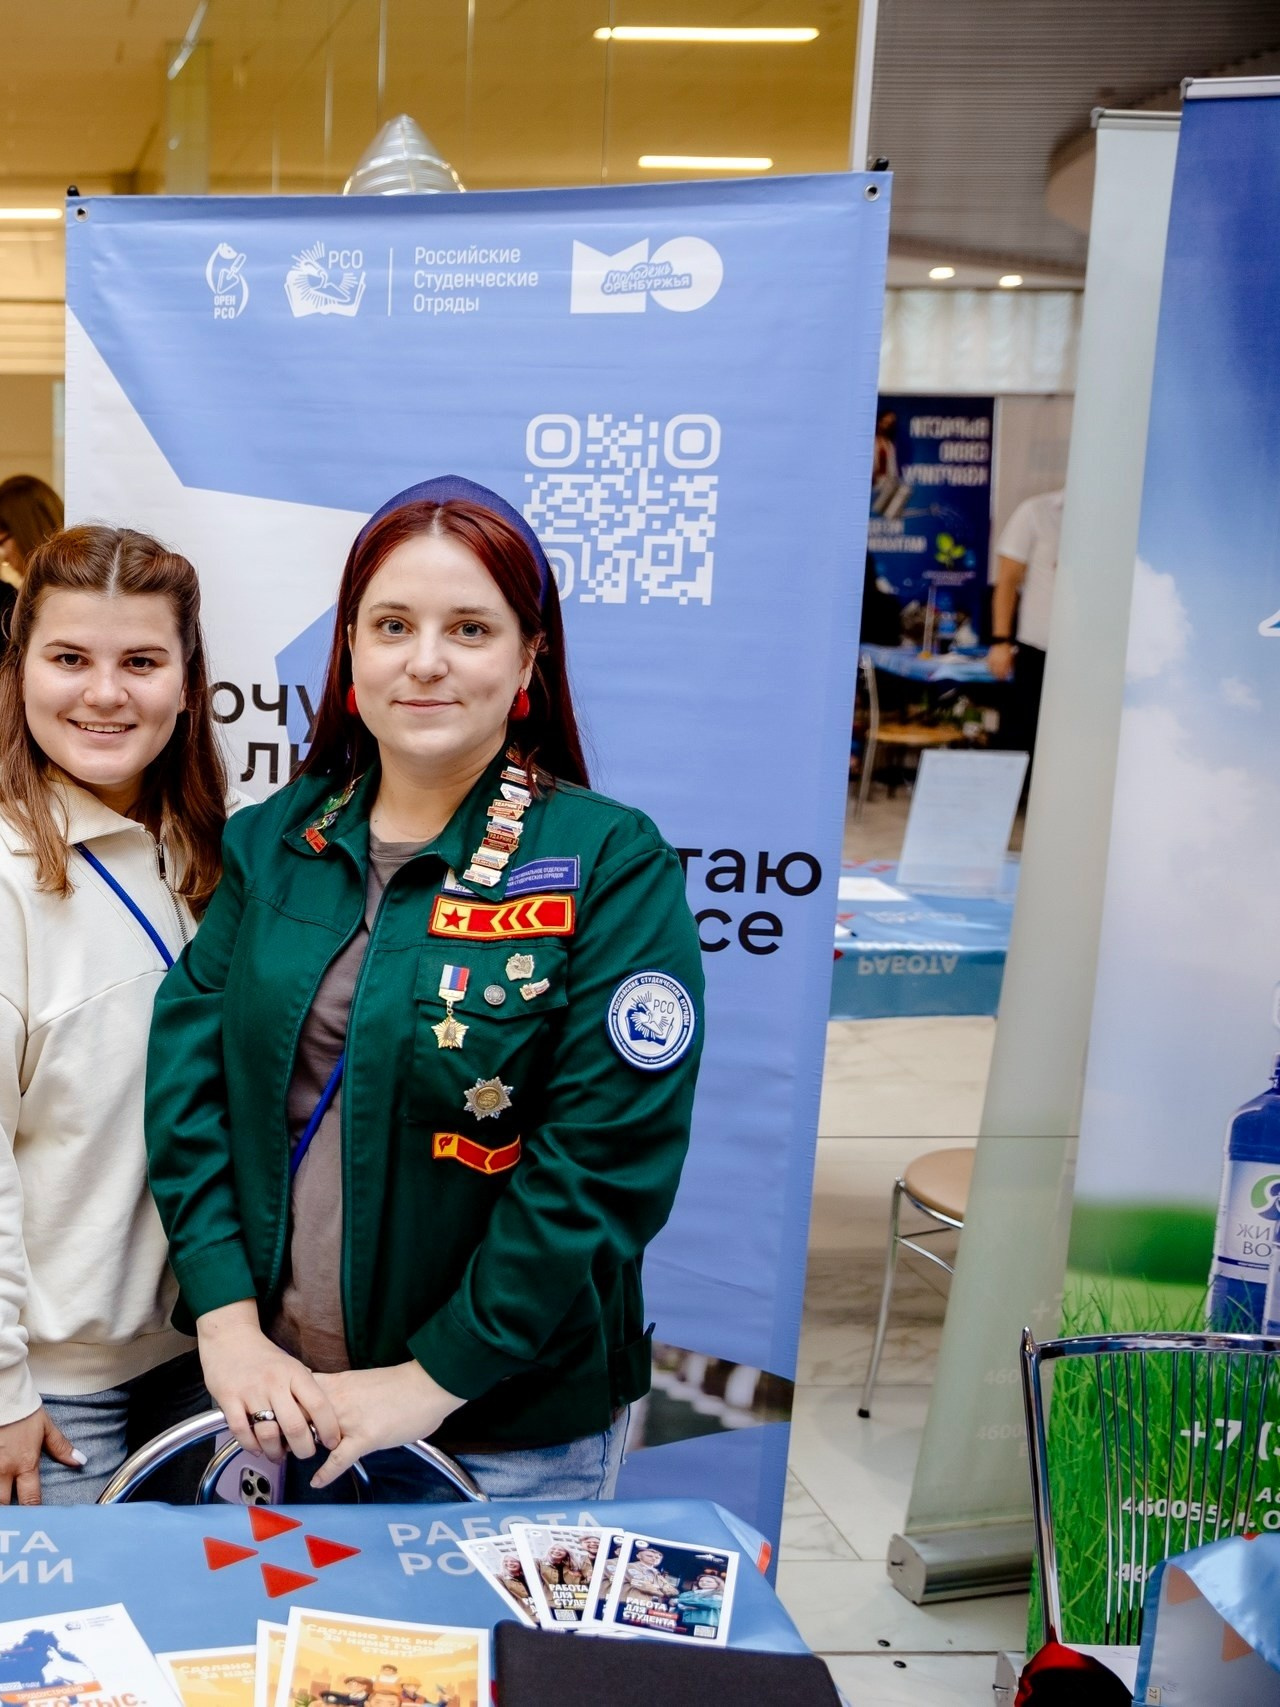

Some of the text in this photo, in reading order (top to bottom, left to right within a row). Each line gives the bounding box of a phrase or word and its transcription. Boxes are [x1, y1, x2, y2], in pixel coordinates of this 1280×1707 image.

[328, 250, 363, 269] РСО
[415, 246, 521, 265] Российские
[414, 271, 538, 291] Студенческие
[603, 275, 690, 293] ОРЕНБУРЖЬЯ
[214, 295, 236, 306] ОРЕН
[413, 294, 479, 315] Отряды
[214, 307, 235, 319] РСО
[640, 976, 683, 999] СТУДЕНЧЕСКИЕ
[680, 998, 690, 1026] ОТРЯДЫ
[653, 999, 675, 1014] РСО
[548, 1584, 589, 1592] РАБОТА
[624, 1605, 647, 1615] ДЛЯ
[626, 1597, 668, 1611] РАБОТА
[623, 1611, 677, 1627] СТУДЕНТА
[305, 1623, 379, 1641] Сделано
